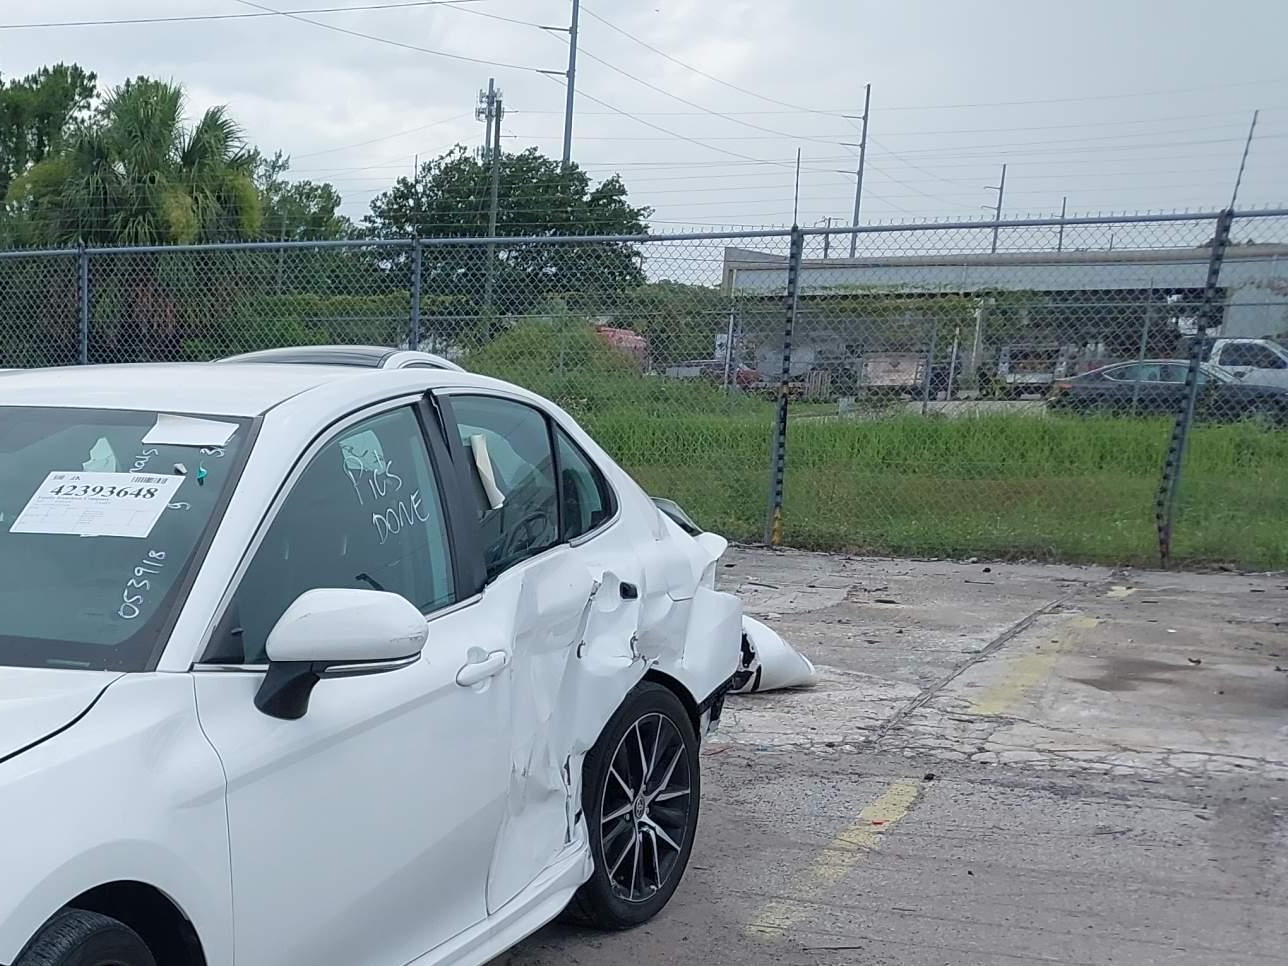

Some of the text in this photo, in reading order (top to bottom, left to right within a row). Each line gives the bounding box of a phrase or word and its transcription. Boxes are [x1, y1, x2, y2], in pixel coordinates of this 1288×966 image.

[50, 484, 159, 500] 42393648
[372, 489, 430, 545] DONE
[118, 550, 166, 619] 053918
